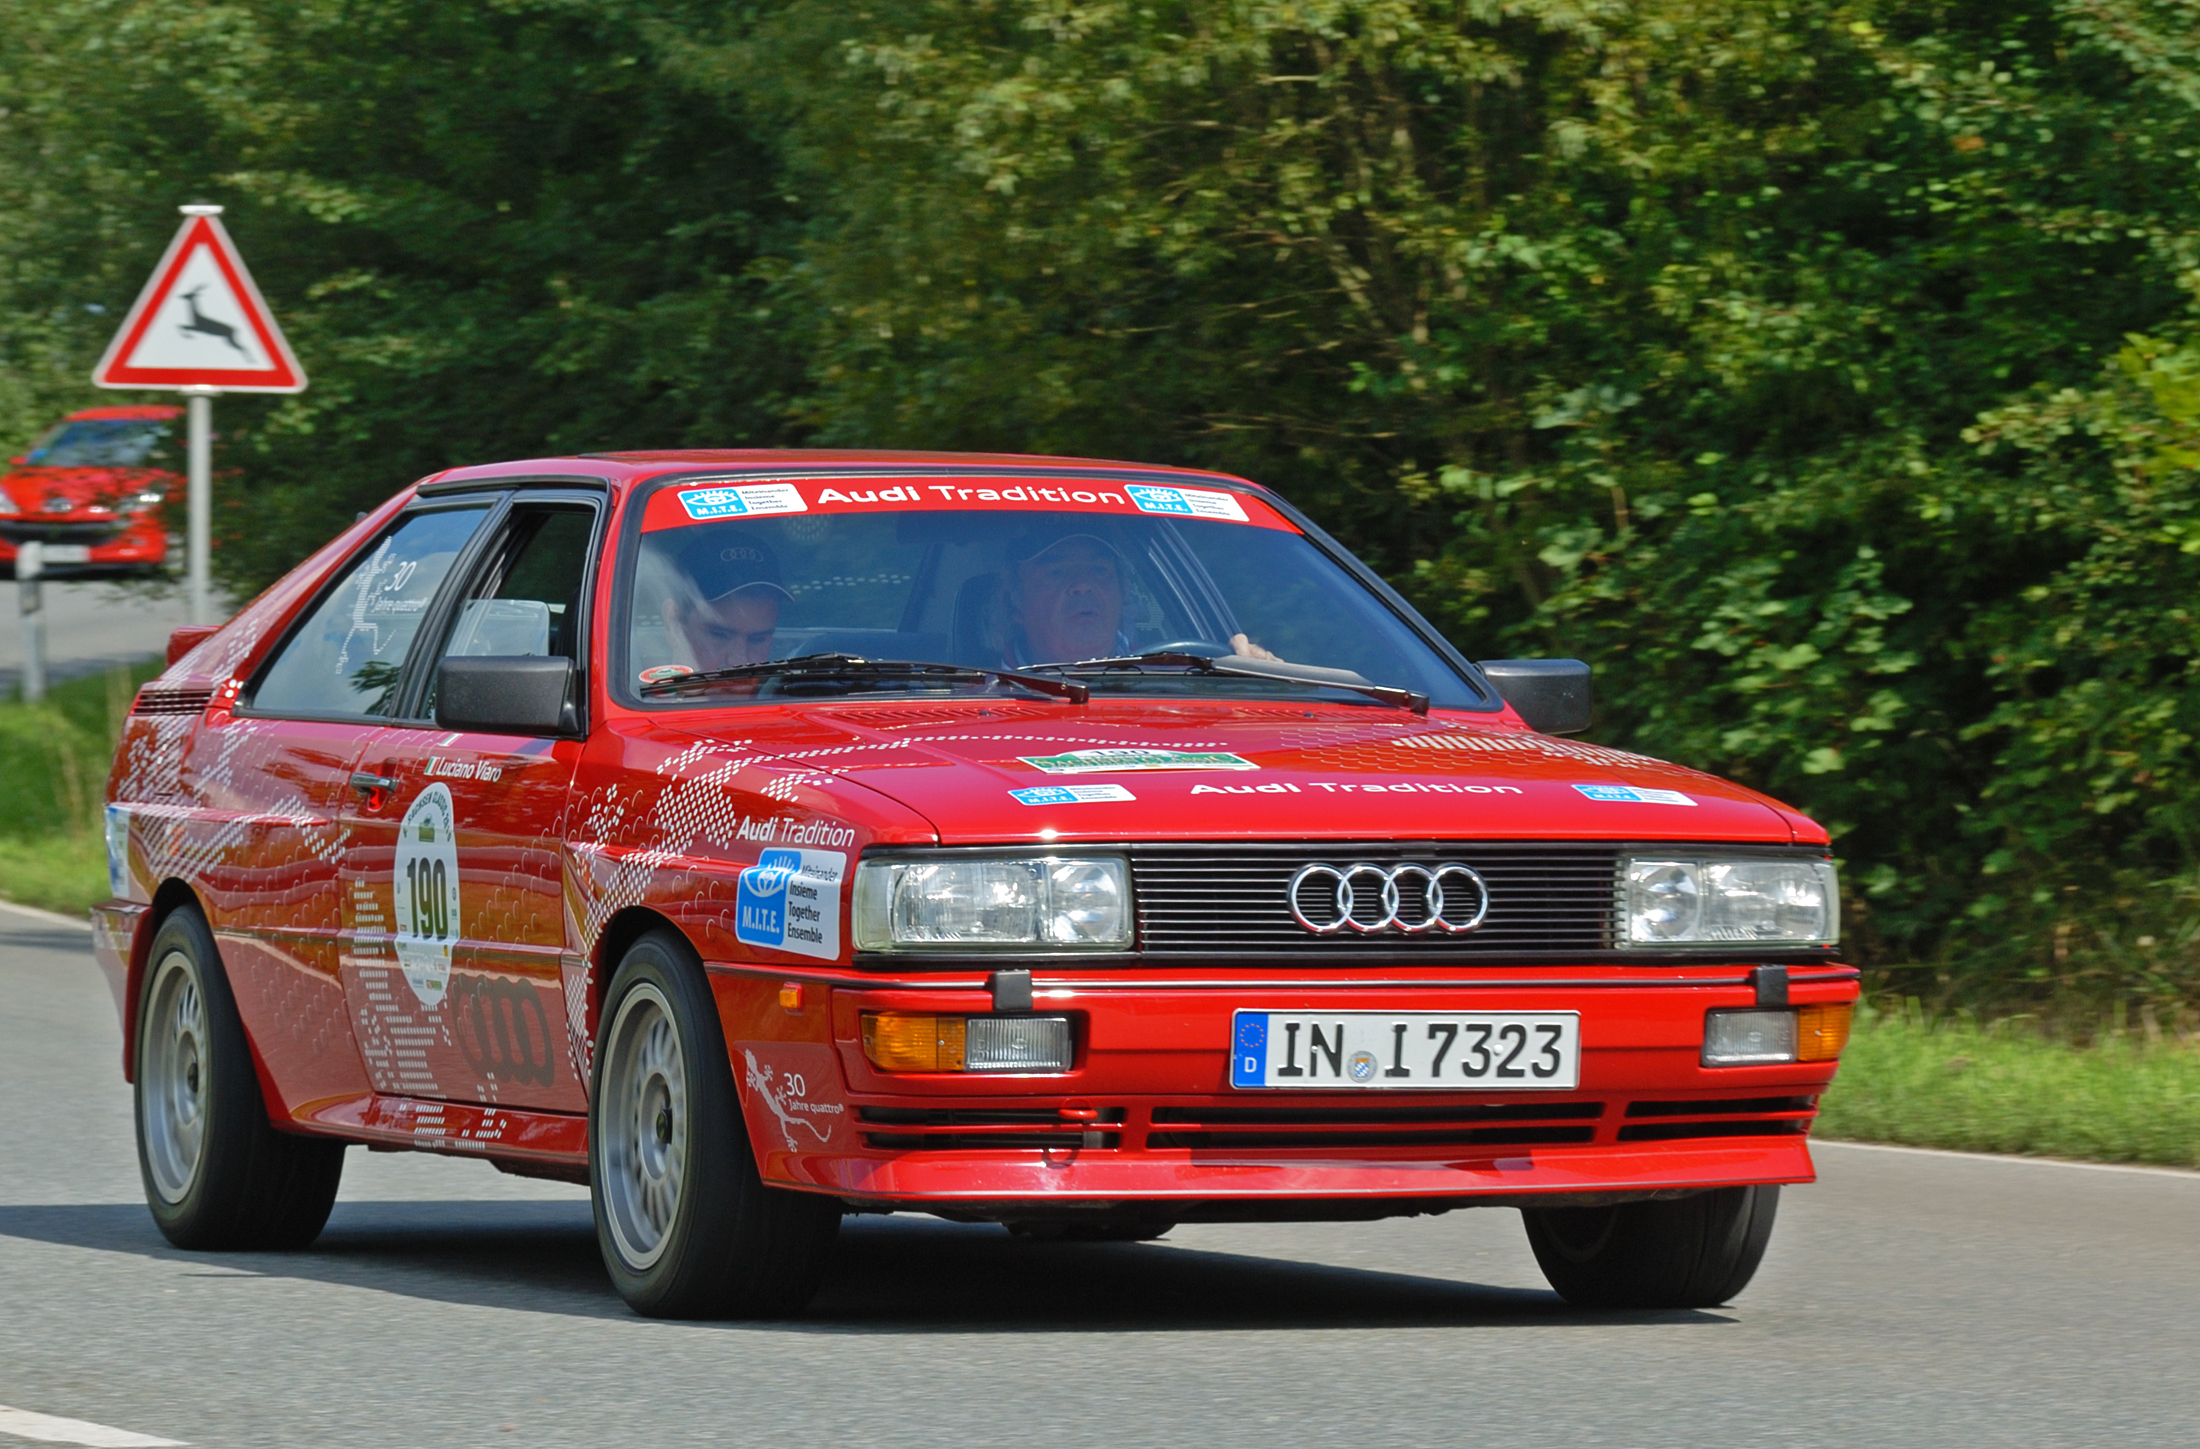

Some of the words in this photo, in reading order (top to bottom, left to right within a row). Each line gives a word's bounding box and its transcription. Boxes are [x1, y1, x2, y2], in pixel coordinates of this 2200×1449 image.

[818, 485, 921, 504] Audi
[928, 485, 1126, 505] Tradition
[696, 504, 743, 516] M.I.T.E.
[384, 560, 417, 592] 30
[436, 757, 474, 779] Luciano
[474, 760, 502, 782] Viaro
[1190, 783, 1302, 795] Audi
[1309, 782, 1525, 795] Tradition
[736, 815, 779, 842] Audi
[780, 817, 856, 848] Tradition
[406, 857, 449, 942] 190
[789, 880, 818, 901] Insieme
[742, 905, 780, 934] M.I.T.E.
[788, 901, 821, 923] Together
[787, 922, 823, 944] Ensemble
[1277, 1022, 1344, 1078] IN
[1384, 1022, 1411, 1078] I
[1427, 1022, 1562, 1079] 7323
[1244, 1057, 1257, 1074] D
[783, 1072, 806, 1098] 30
[788, 1099, 810, 1112] Jahre
